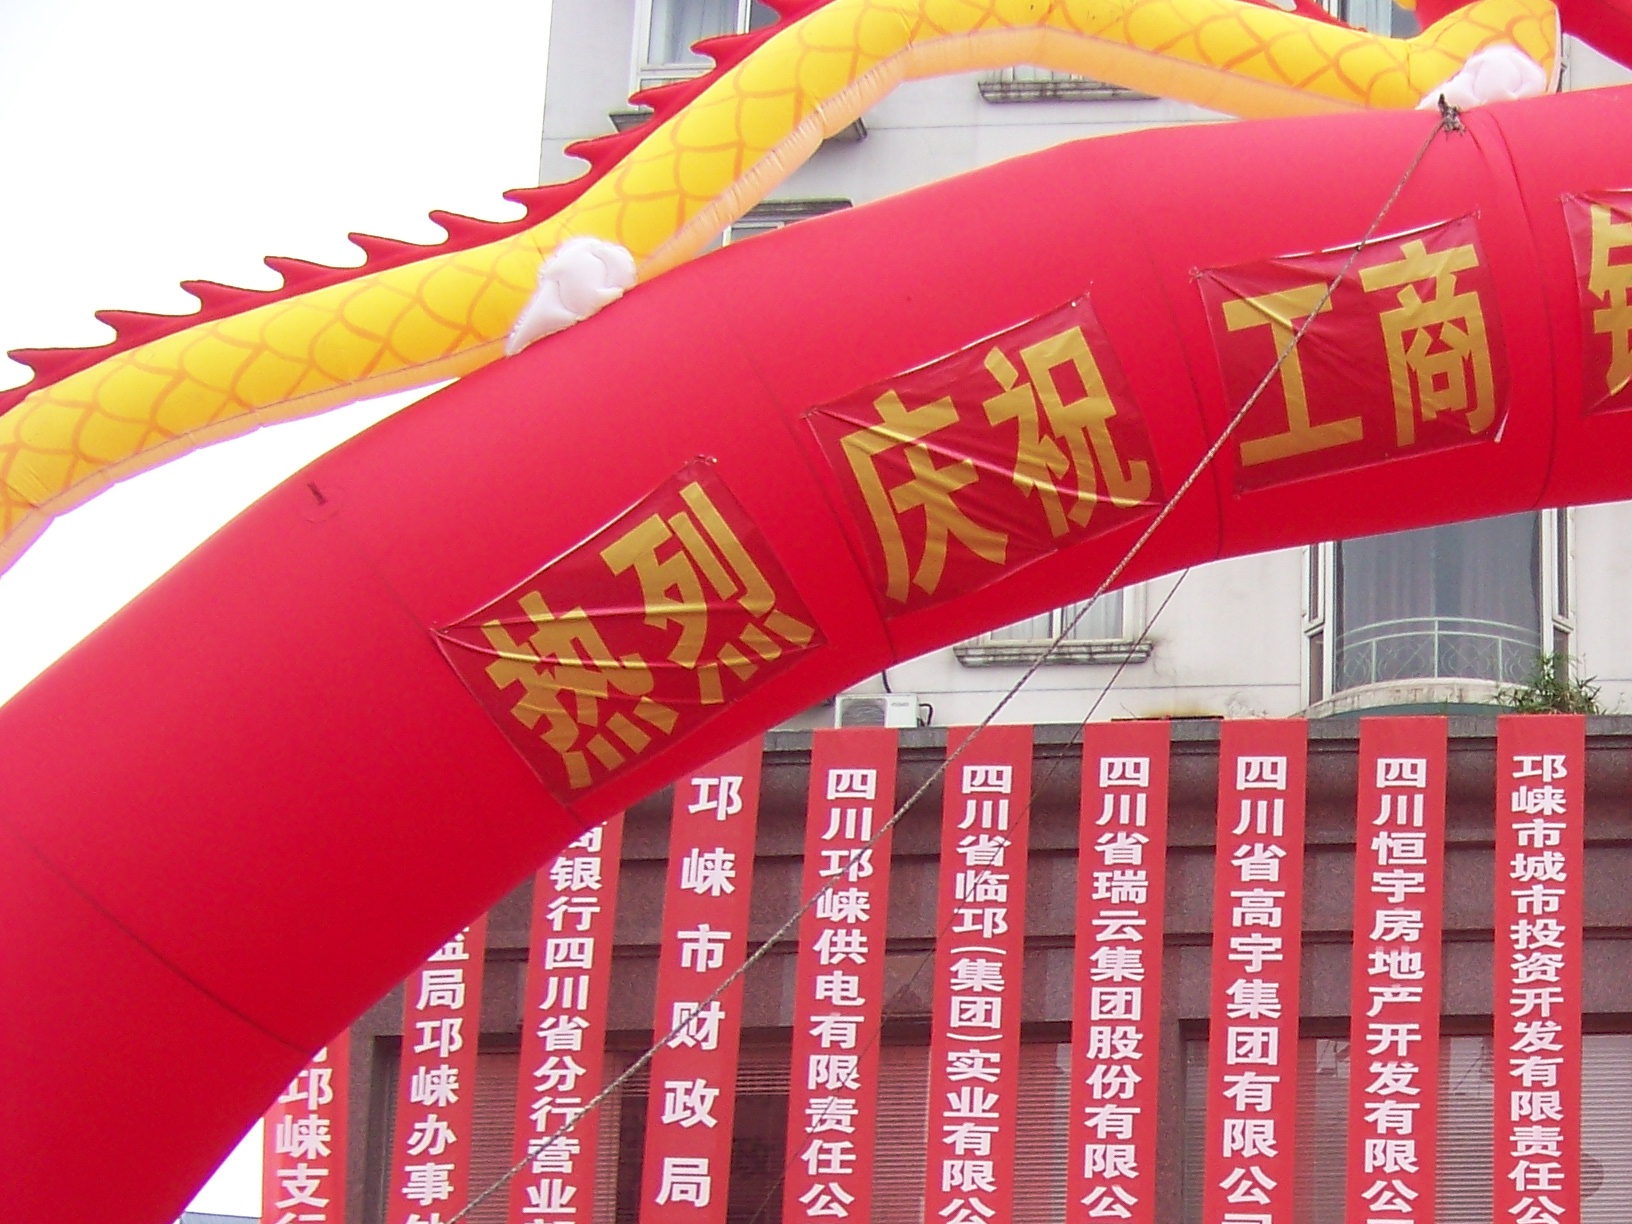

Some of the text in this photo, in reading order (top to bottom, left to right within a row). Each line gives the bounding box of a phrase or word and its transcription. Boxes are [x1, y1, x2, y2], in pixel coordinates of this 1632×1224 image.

[483, 480, 814, 789] 热烈
[839, 326, 1152, 602] 庆祝
[1222, 239, 1496, 467] 工商
